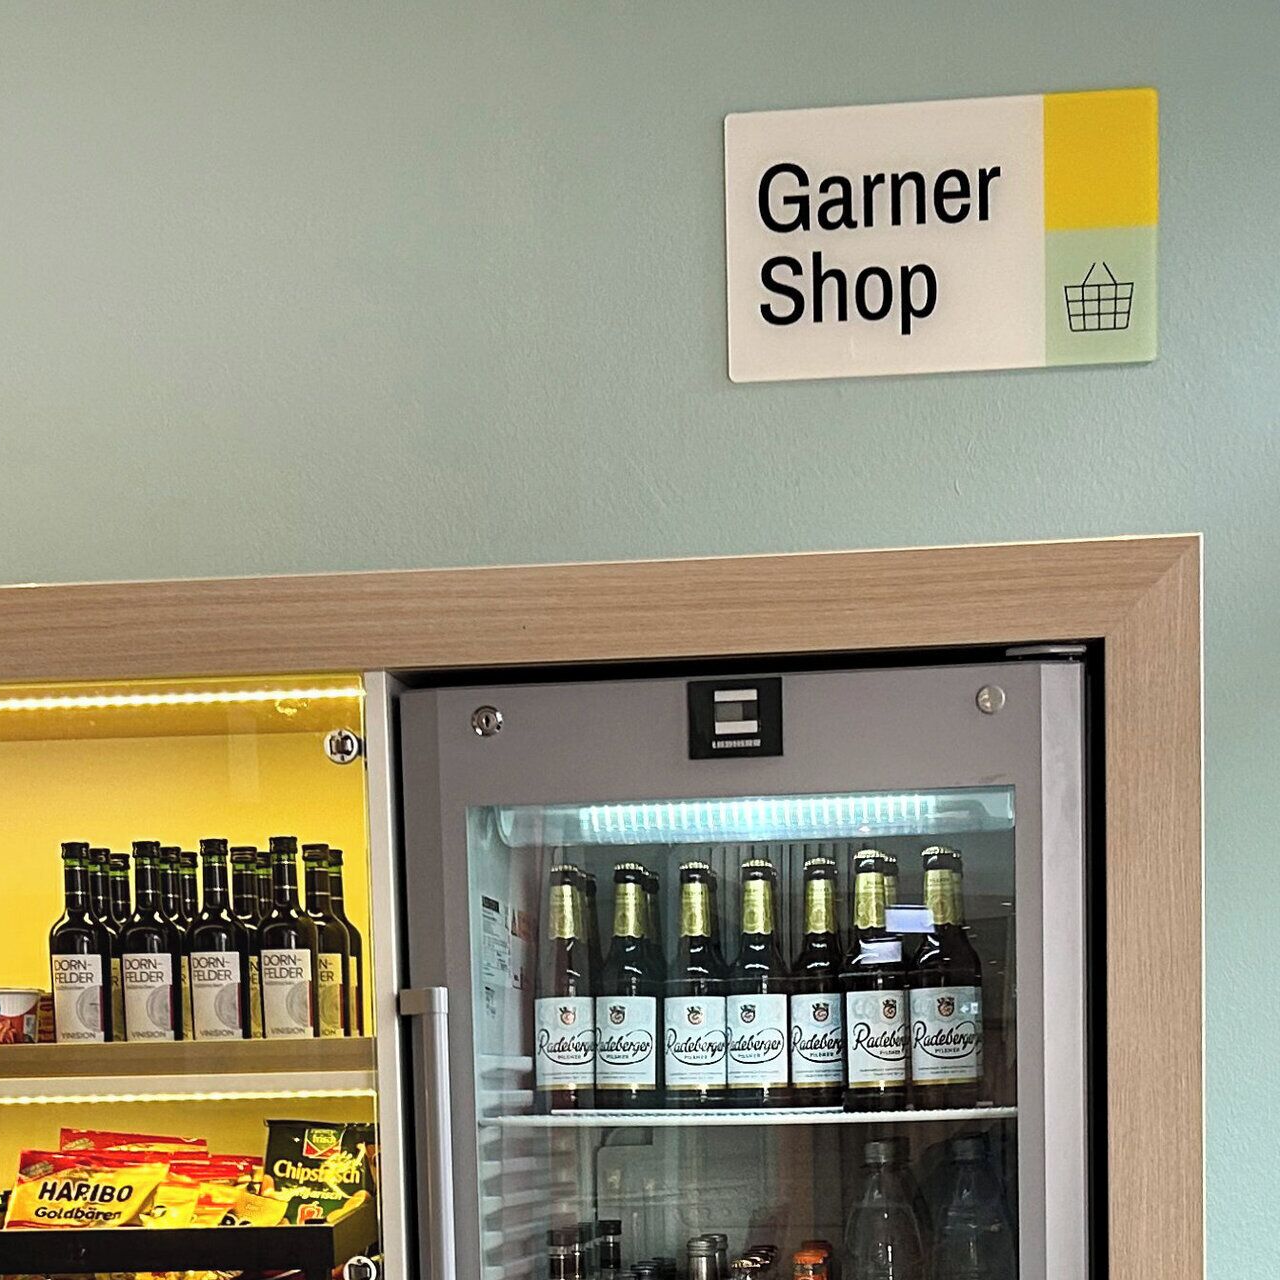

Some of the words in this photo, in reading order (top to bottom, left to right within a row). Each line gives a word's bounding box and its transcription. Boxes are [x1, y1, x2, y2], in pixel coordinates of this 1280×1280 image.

[758, 162, 1001, 233] Garner
[759, 251, 937, 335] Shop
[54, 959, 92, 971] DORN-
[125, 958, 163, 971] DORN-
[192, 956, 231, 969] DORN-
[264, 954, 302, 967] DORN-
[54, 971, 94, 984] FELDER
[125, 971, 165, 983] FELDER
[193, 969, 232, 982] FELDER
[264, 967, 304, 980] FELDER
[273, 1159, 360, 1185] Chipssch
[38, 1181, 134, 1203] HARIBO
[34, 1206, 122, 1222] Goldbären
